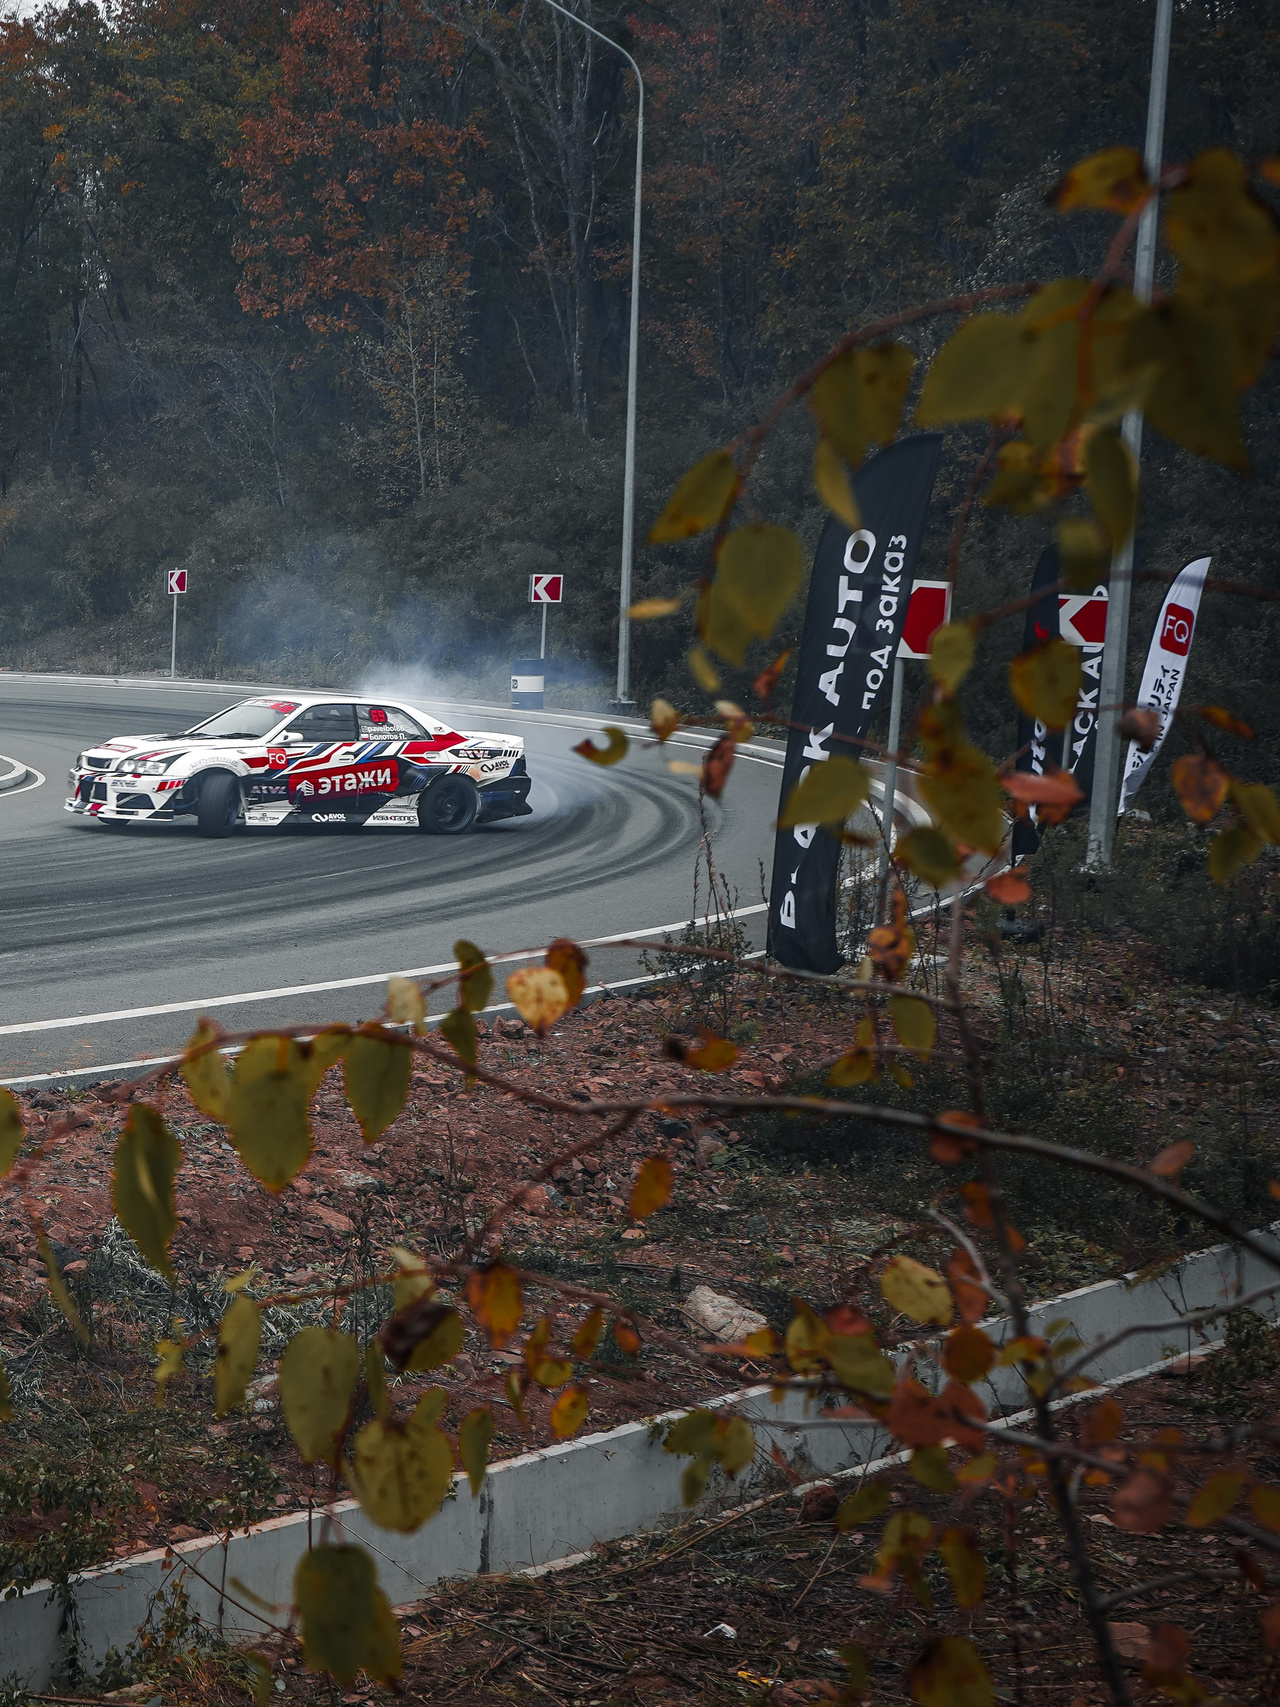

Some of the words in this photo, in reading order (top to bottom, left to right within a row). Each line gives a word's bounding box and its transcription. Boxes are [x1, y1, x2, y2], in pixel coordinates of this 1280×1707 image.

[875, 534, 908, 635] заказ
[1163, 614, 1189, 644] FQ
[861, 645, 893, 710] под
[1162, 668, 1181, 721] JAPAN
[268, 753, 287, 764] FQ
[780, 722, 835, 930] BAK
[818, 528, 877, 707] AUTO
